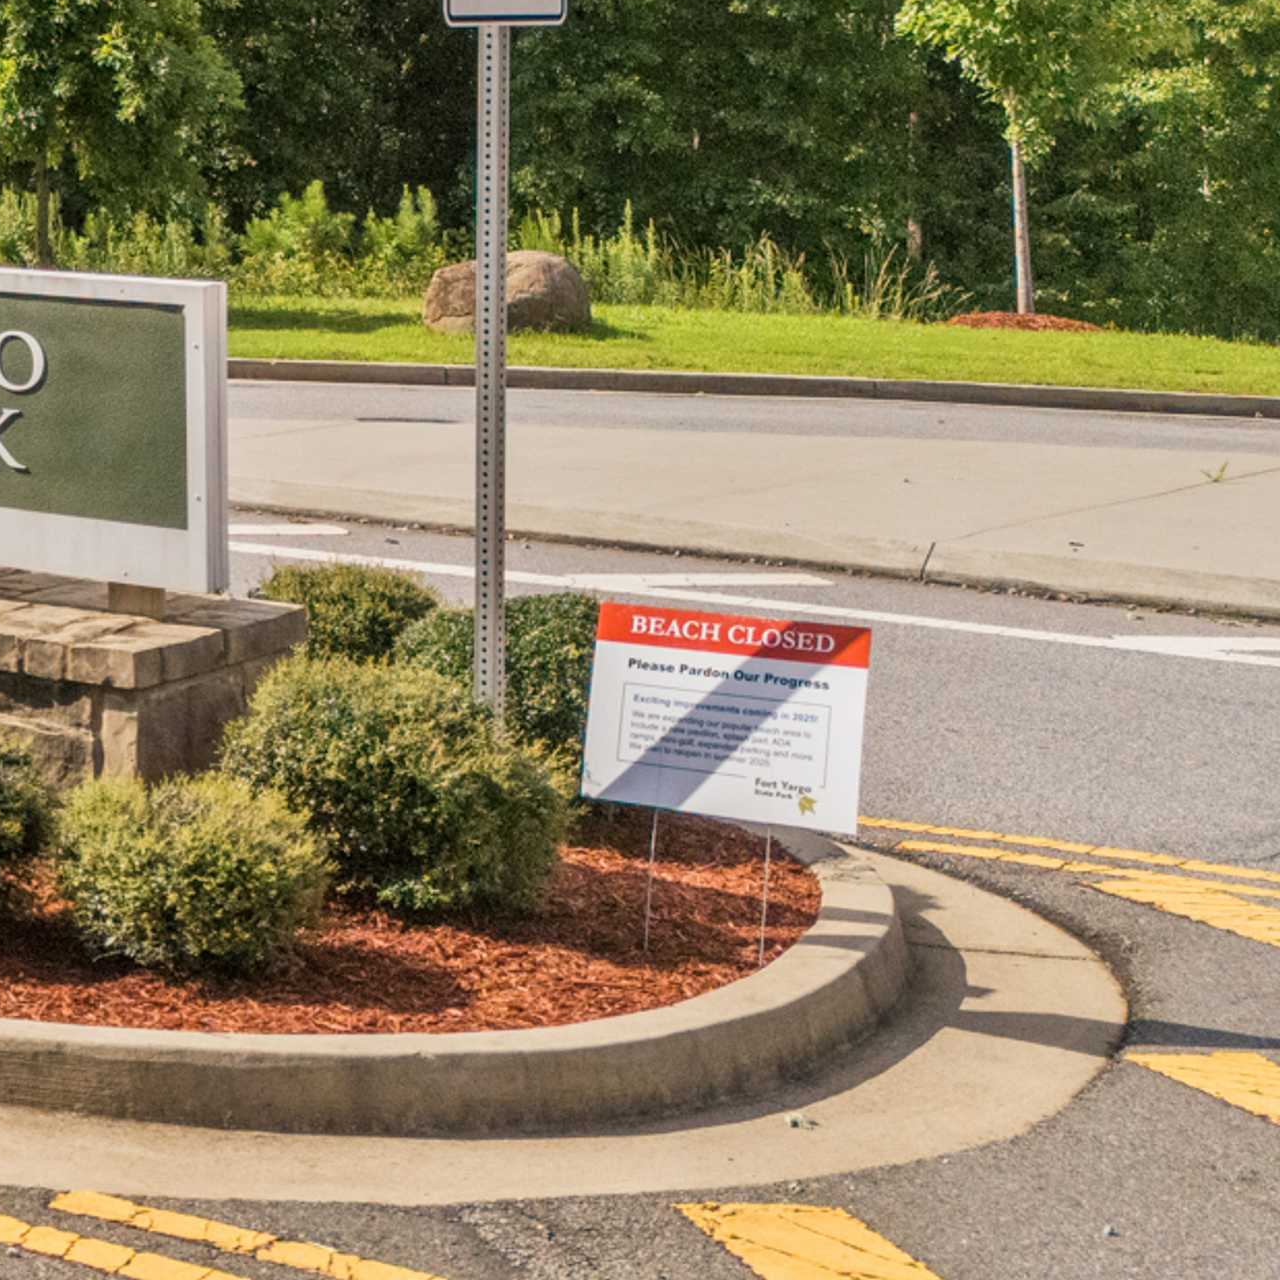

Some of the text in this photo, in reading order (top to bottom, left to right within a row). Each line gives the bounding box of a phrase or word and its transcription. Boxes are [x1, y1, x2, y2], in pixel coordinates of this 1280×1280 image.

[630, 614, 836, 653] BEACH CLOSED
[628, 657, 830, 691] Please Pardon Our Progress
[754, 777, 812, 794] Fort Yargo
